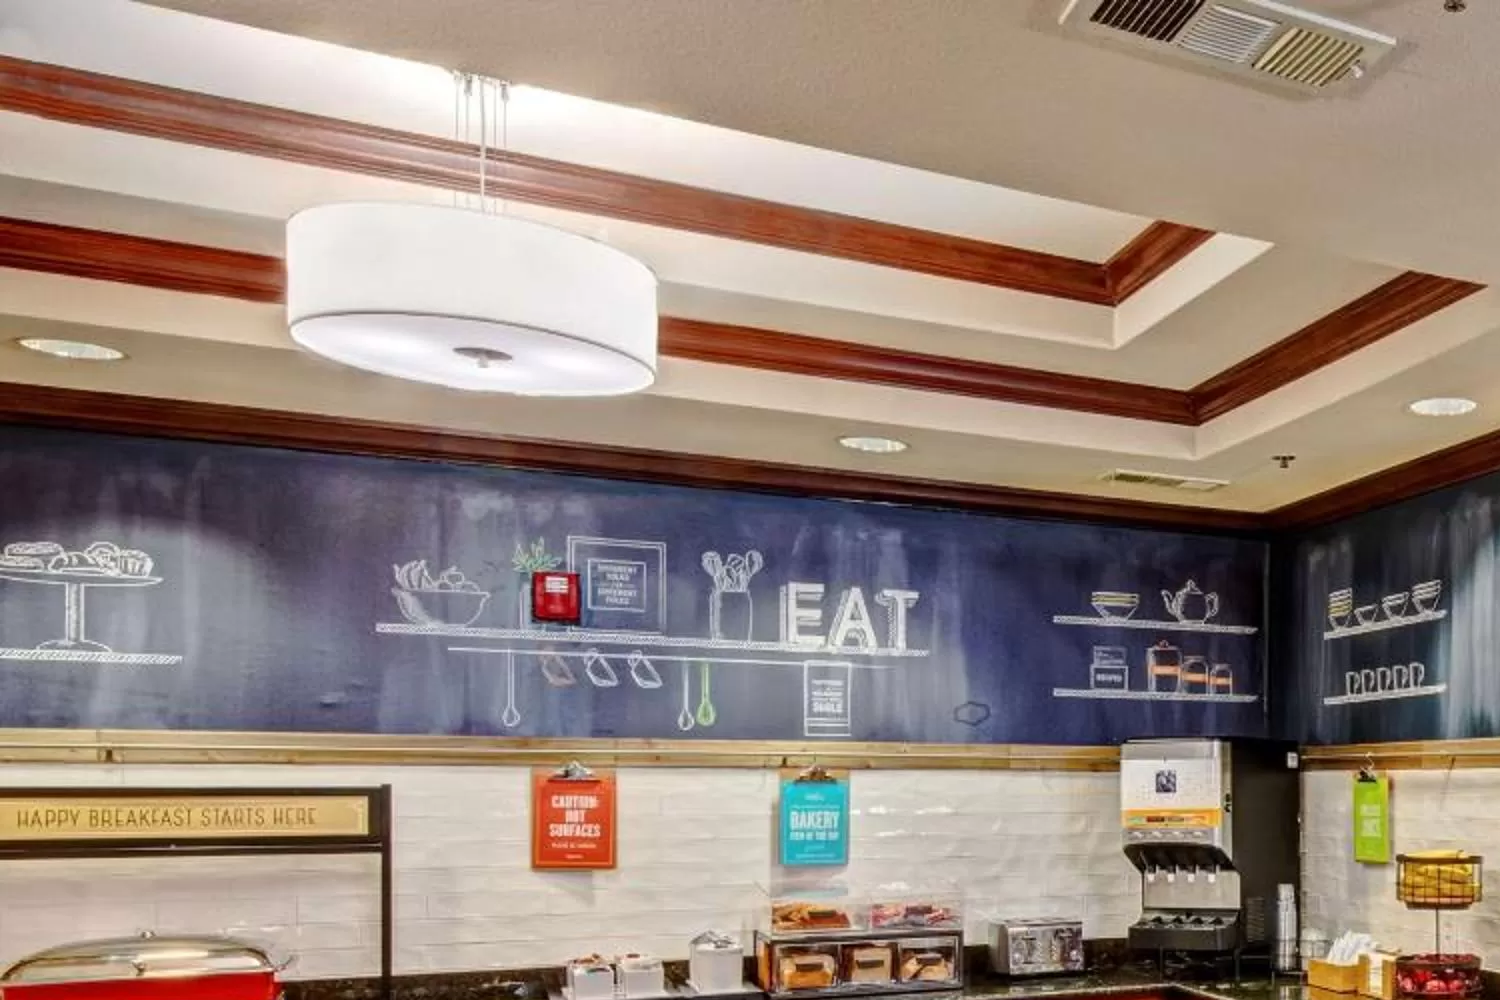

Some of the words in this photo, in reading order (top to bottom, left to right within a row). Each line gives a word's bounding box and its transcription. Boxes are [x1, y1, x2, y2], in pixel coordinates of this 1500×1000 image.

[780, 581, 920, 653] EAT
[16, 808, 80, 829] HAPPY
[89, 806, 192, 829] BREAKFAST
[200, 806, 265, 828] STARTS
[273, 806, 318, 827] HERE
[565, 809, 584, 822] HOT
[790, 811, 840, 829] BAKERY
[549, 823, 601, 837] SURFACES
